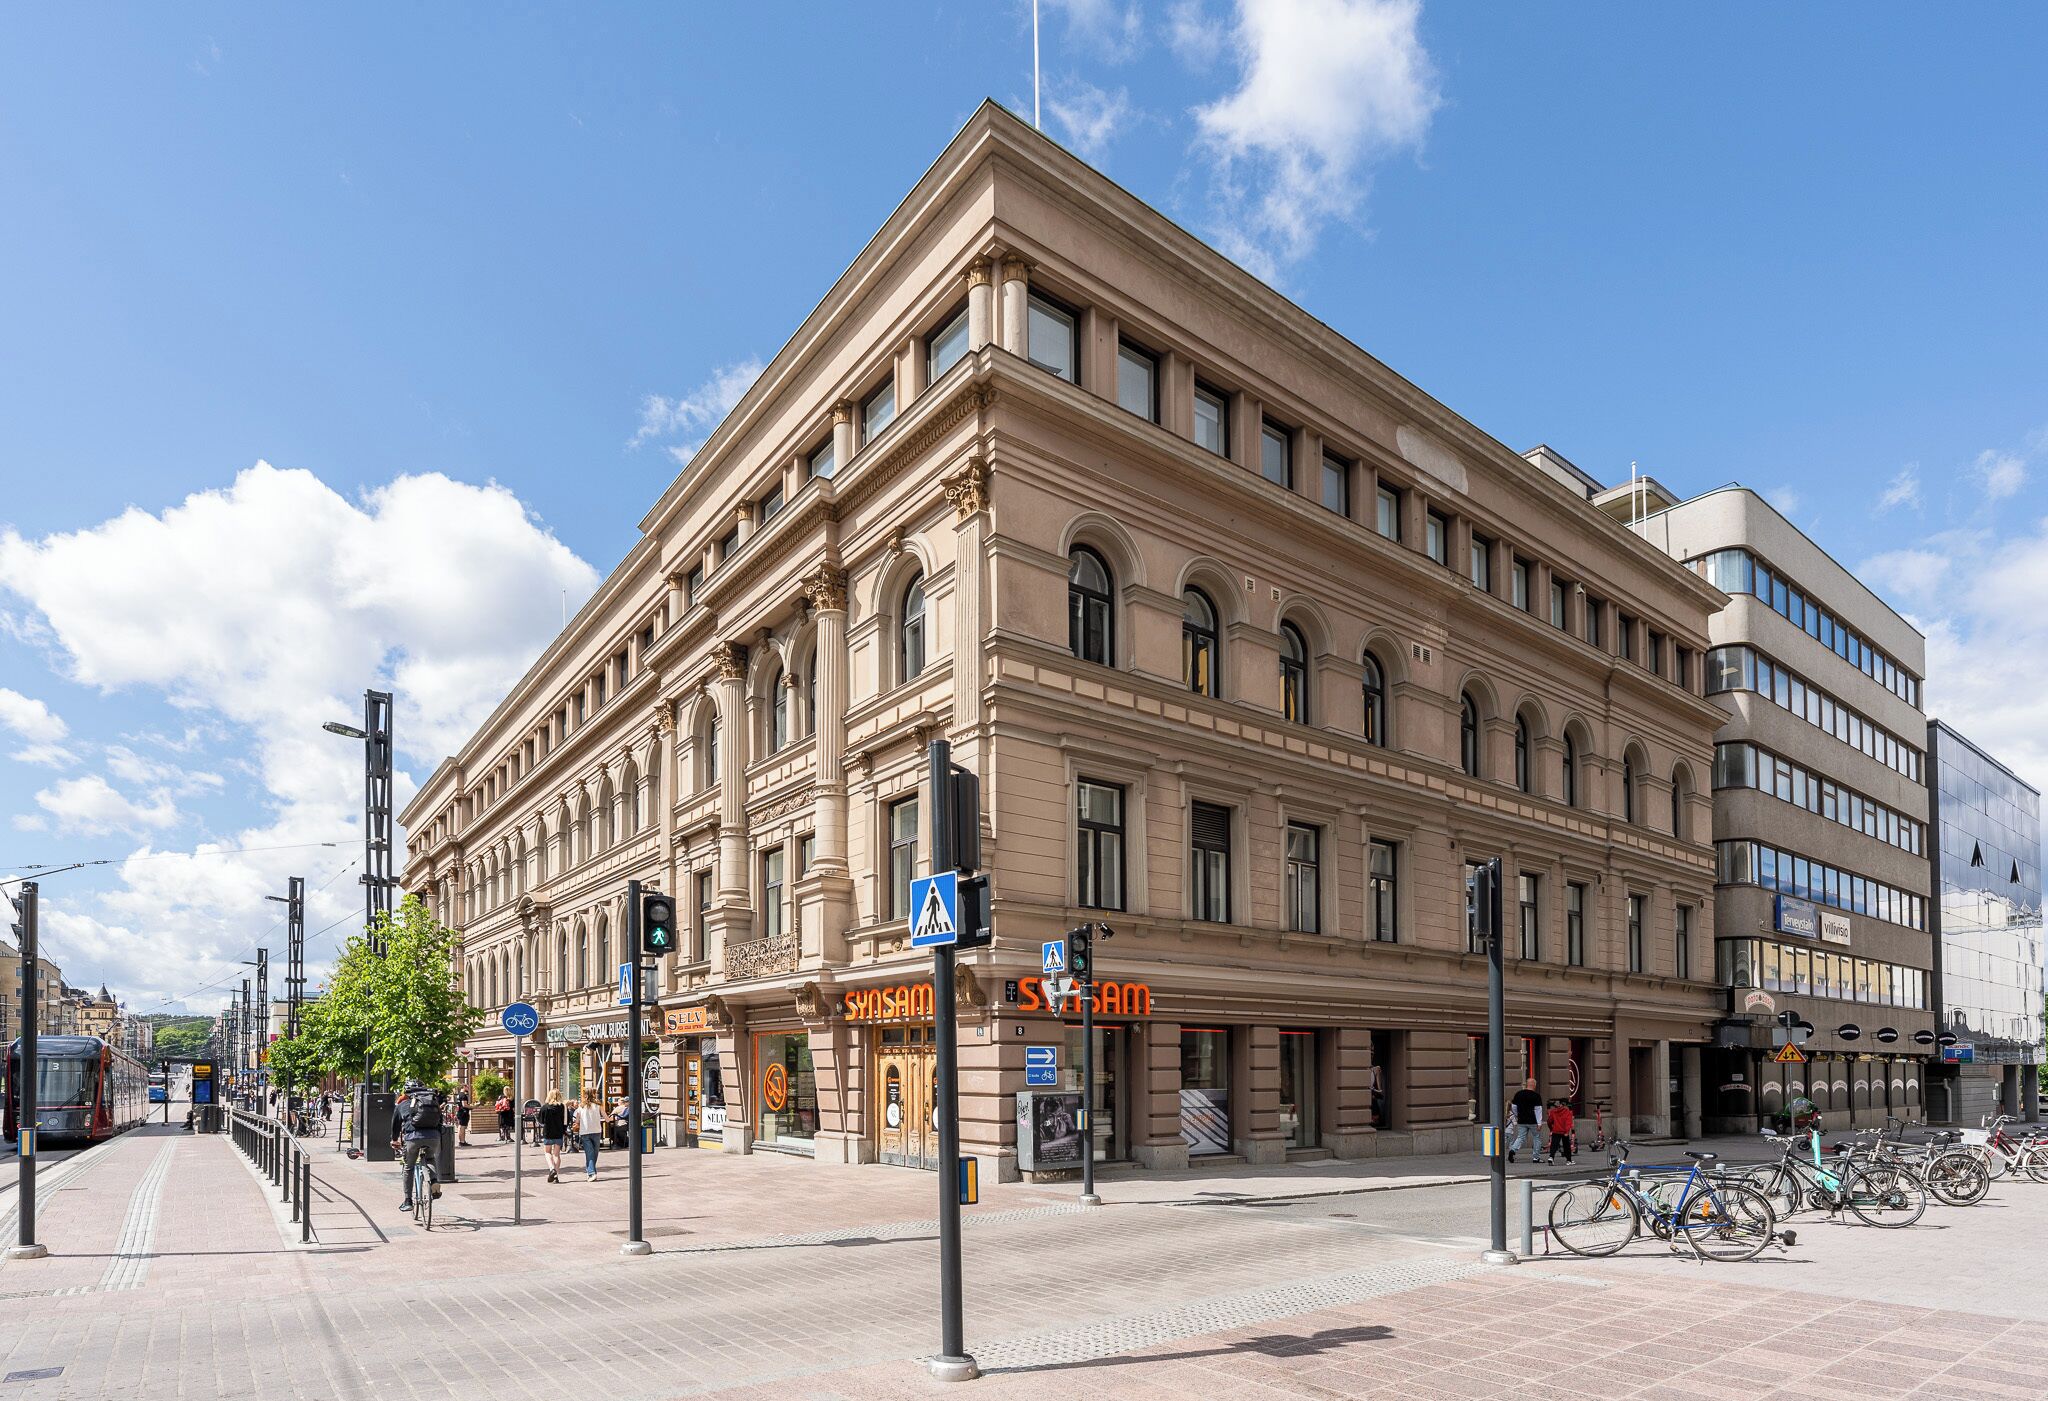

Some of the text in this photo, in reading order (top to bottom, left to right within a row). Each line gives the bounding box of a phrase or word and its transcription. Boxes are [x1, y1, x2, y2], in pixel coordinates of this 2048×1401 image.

[1783, 914, 1814, 930] Terveystalo
[1824, 921, 1848, 938] villivisio
[845, 983, 935, 1020] SYNSAM
[1018, 977, 1151, 1016] SNAM
[668, 1011, 712, 1030] SELV
[1017, 1027, 1023, 1035] 8
[1954, 1049, 1963, 1058] P
[52, 1062, 60, 1071] 3
